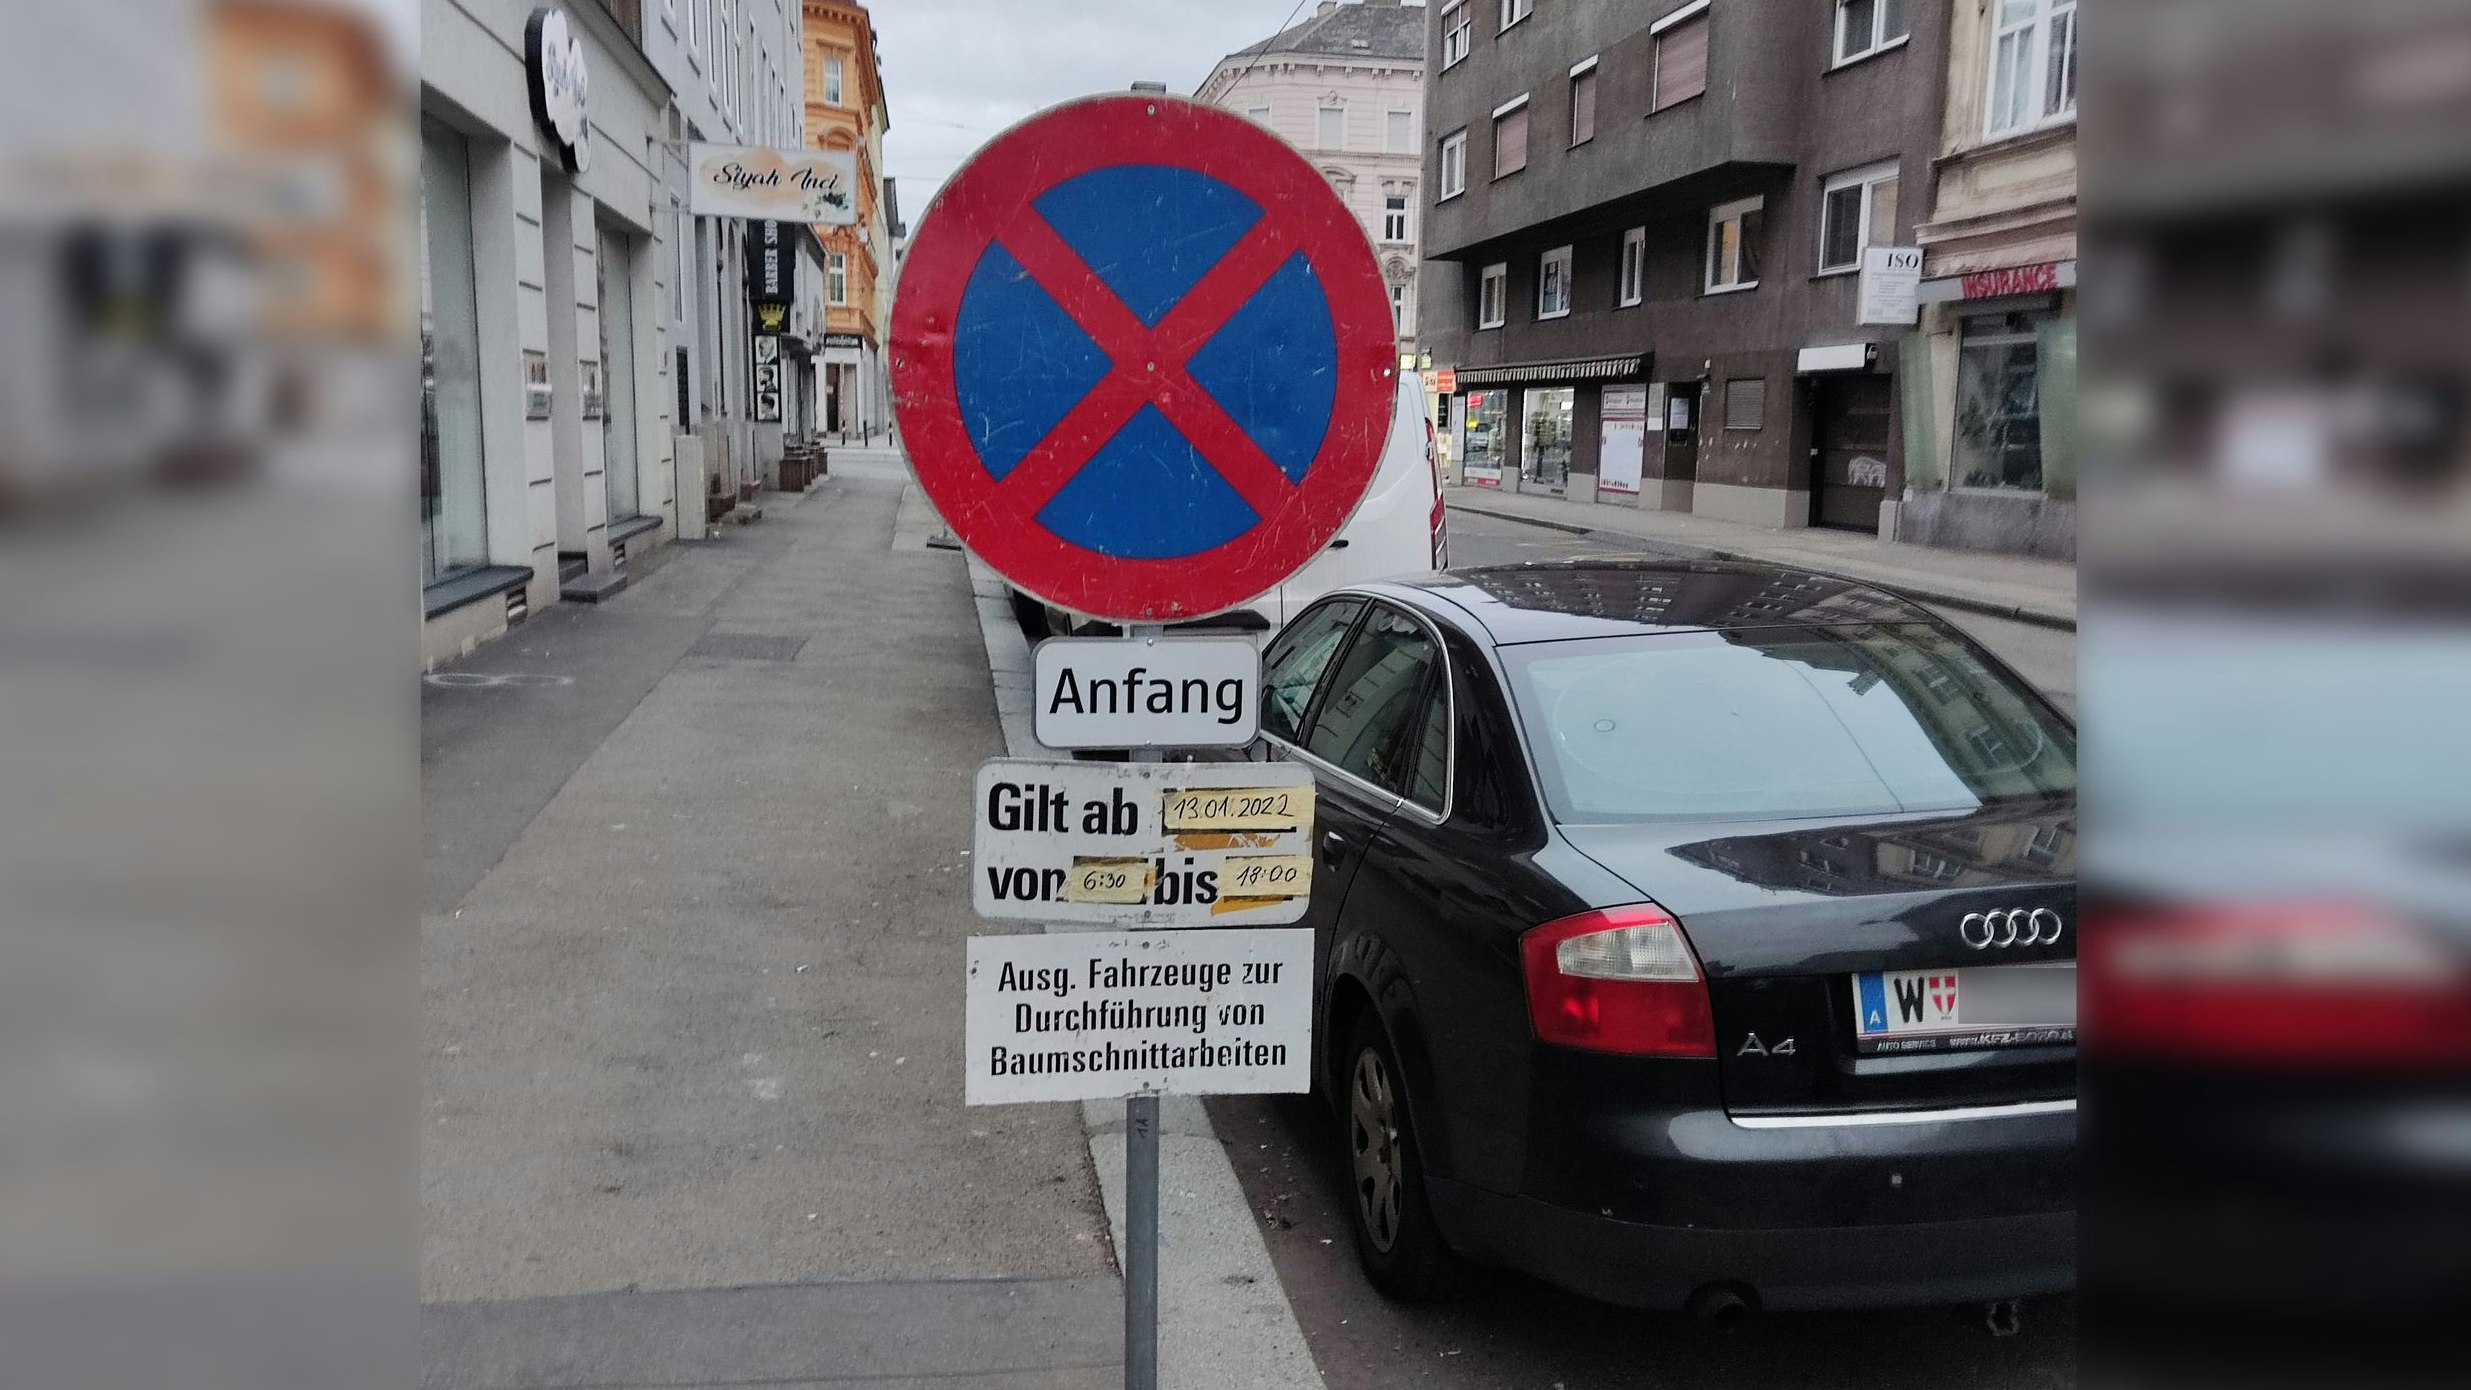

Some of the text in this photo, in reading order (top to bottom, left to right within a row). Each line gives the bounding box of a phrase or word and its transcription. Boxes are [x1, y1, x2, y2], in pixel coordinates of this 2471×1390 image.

[713, 162, 782, 190] Siyah
[764, 220, 778, 293] BARBER SHO
[1887, 253, 1919, 268] ISO
[1962, 262, 2058, 298] INSURANCE
[1049, 668, 1243, 724] Anfang
[988, 782, 1069, 833] Gilt
[1082, 787, 1138, 835] ab
[1083, 871, 1126, 890] 6:30
[1154, 857, 1218, 905] bis
[1236, 865, 1297, 887] 18:00
[998, 958, 1283, 997] Ausg. Fahrzeuge zur
[1015, 999, 1265, 1034] Durchführung von
[1869, 1010, 1882, 1025] A
[1893, 976, 1925, 1023] W
[991, 1037, 1287, 1076] Baumschnittarbeiten
[1737, 1032, 1796, 1056] A4
